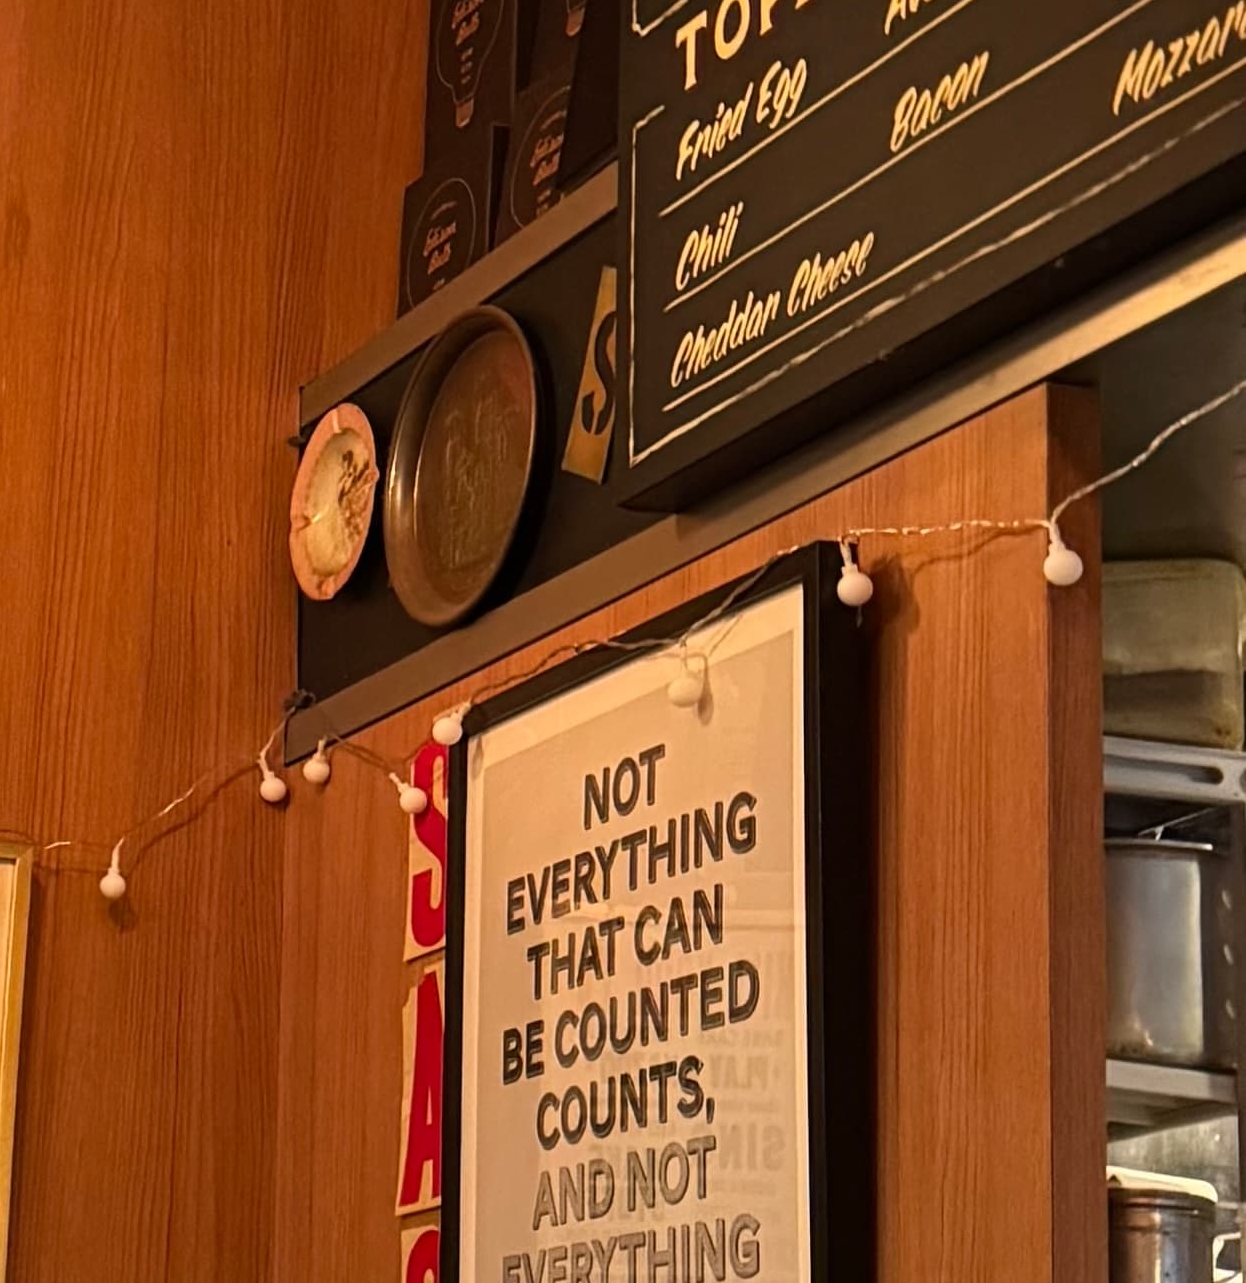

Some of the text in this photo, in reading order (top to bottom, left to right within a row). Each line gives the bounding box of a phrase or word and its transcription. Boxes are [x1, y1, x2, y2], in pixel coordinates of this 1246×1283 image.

[675, 58, 808, 180] Fried Egg
[890, 51, 990, 152] Bacon
[674, 200, 744, 292] Chili
[671, 231, 875, 388] Cheddar Cheese
[582, 743, 666, 830] NOT
[506, 791, 758, 936] EVERYTHING
[527, 883, 725, 1001] THAT CAN
[502, 959, 760, 1086] BE COUNTED
[536, 1054, 716, 1151] COUNTS,
[532, 1135, 717, 1230] AND NOT
